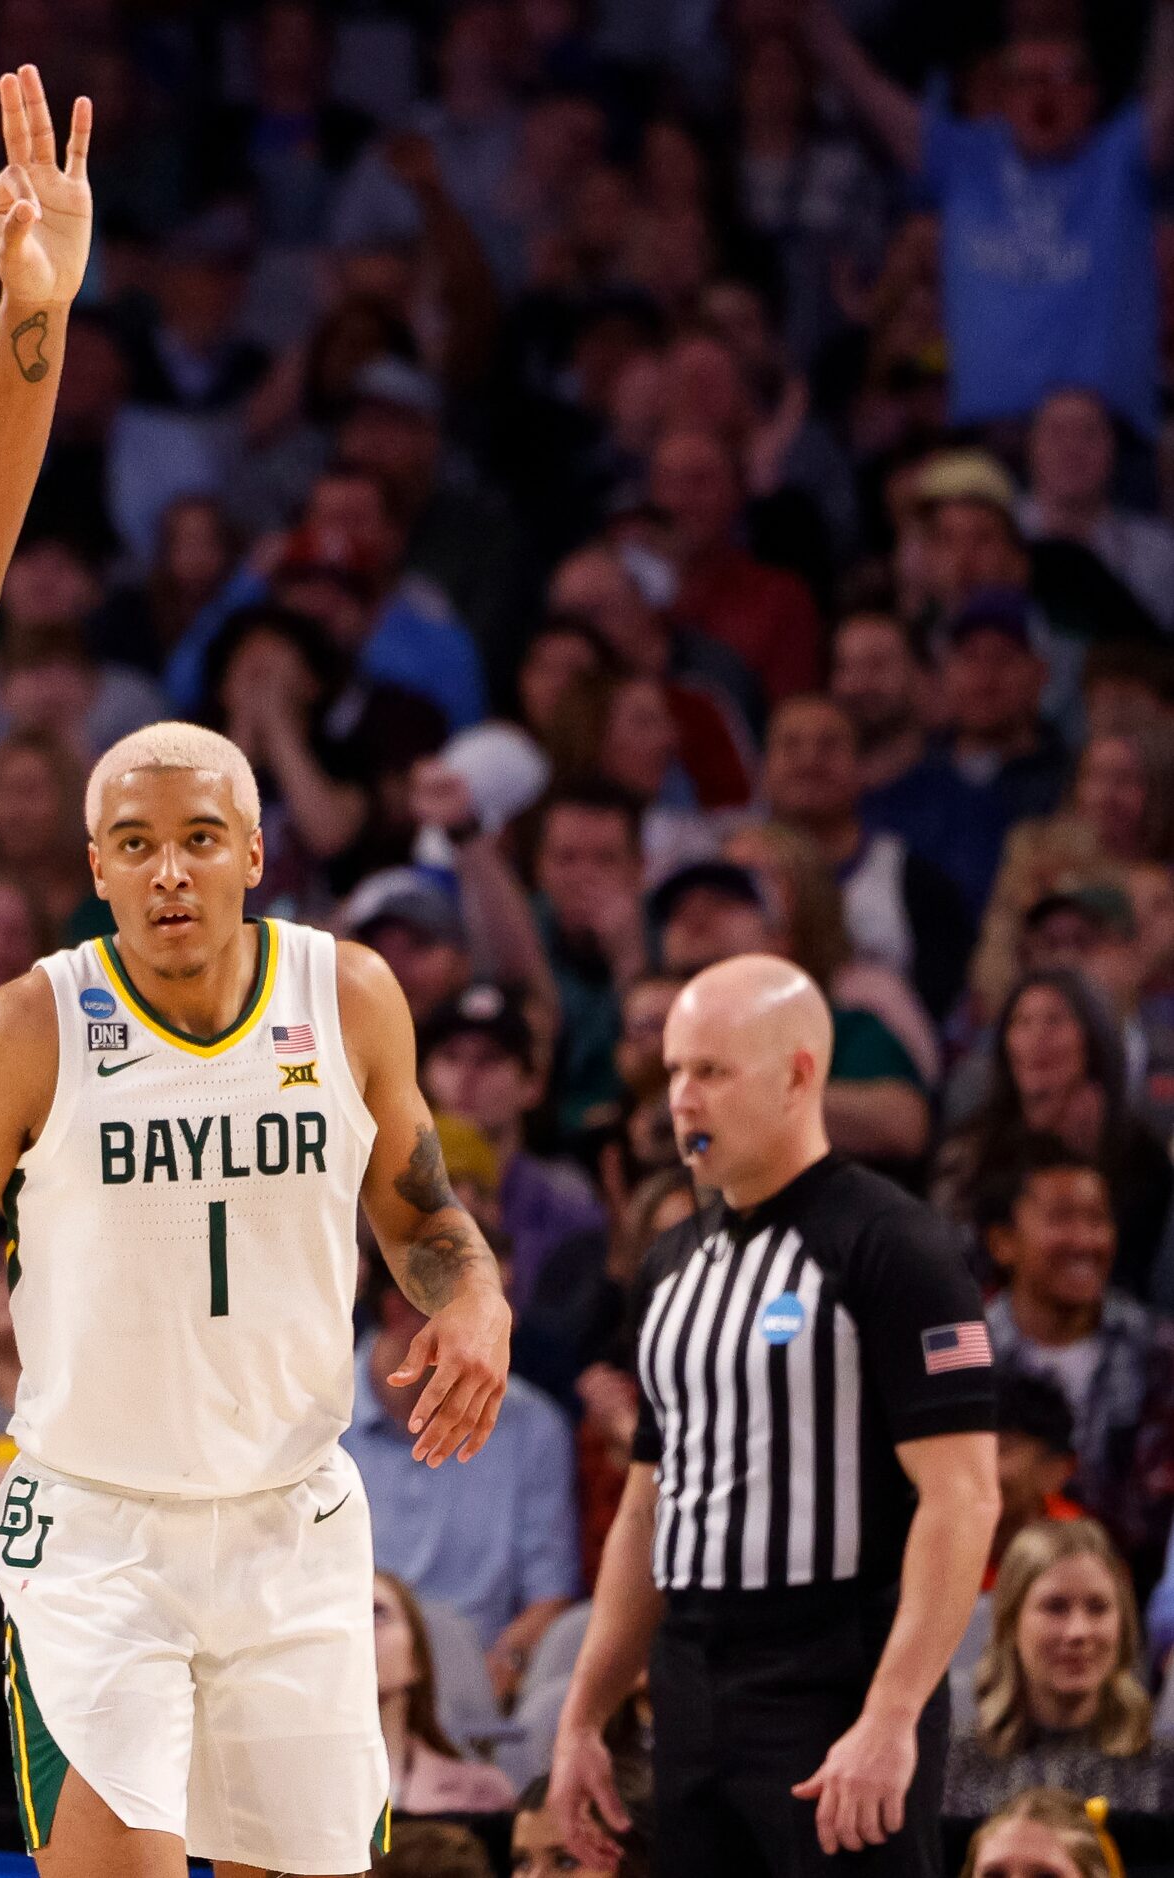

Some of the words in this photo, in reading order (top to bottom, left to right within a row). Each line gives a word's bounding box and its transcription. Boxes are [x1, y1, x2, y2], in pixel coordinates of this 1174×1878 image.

[91, 1024, 124, 1044] ONE
[279, 1061, 319, 1087] XII
[100, 1111, 327, 1184] BAYLOR
[208, 1200, 229, 1317] 1
